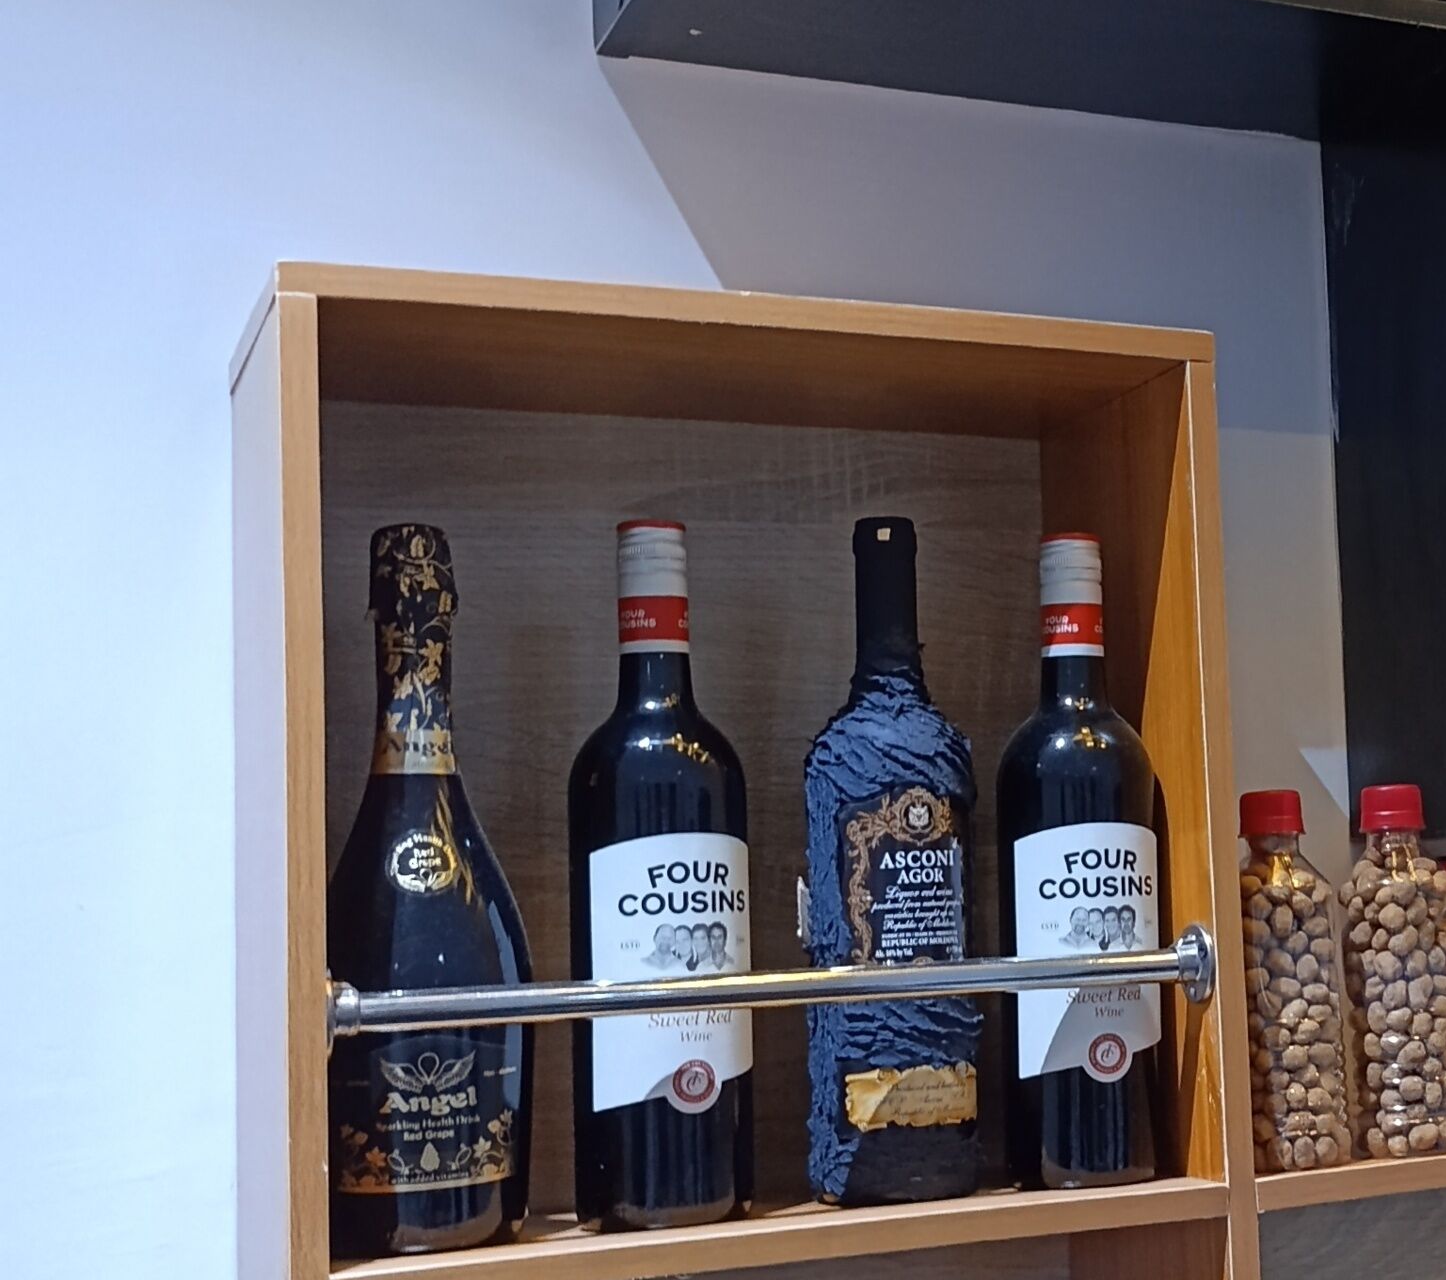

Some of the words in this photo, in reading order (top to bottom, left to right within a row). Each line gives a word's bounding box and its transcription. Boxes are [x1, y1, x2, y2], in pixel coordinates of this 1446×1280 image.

[880, 849, 954, 870] ASCONI
[1063, 847, 1138, 874] FOUR
[647, 860, 729, 889] FOUR
[897, 868, 945, 885] AGOR
[1038, 874, 1153, 900] COUSINS
[618, 889, 745, 917] COUSINS
[881, 938, 919, 948] REPUBLIC
[1066, 987, 1112, 1004] Sweet
[1117, 986, 1142, 1001] Red
[649, 1011, 701, 1029] Sweet
[706, 1008, 733, 1027] Red
[1093, 1005, 1125, 1018] Wine
[680, 1030, 713, 1043] Wine
[379, 1084, 478, 1117] Angel
[403, 1130, 424, 1140] Red
[425, 1128, 455, 1140] Grape
